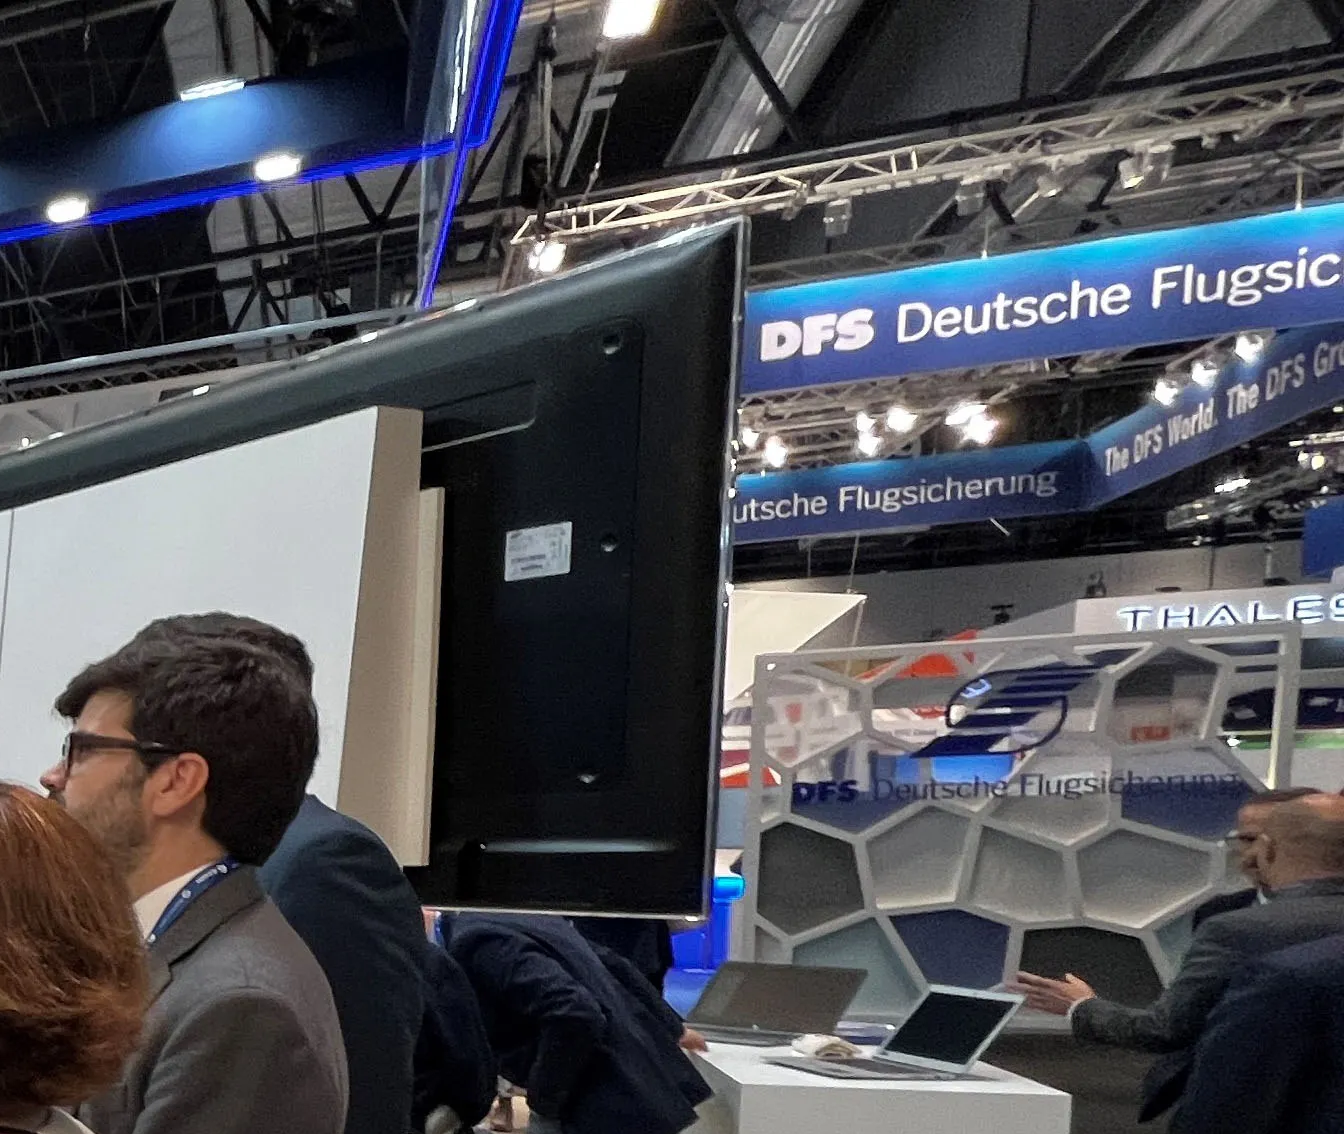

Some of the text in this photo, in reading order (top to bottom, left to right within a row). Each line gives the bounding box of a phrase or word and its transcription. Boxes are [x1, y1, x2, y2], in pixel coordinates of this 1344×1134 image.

[759, 246, 1342, 362] DFS Deutsche Flugsic
[1104, 447, 1130, 476] The
[1133, 423, 1163, 464] DFS
[1226, 383, 1260, 420] The
[1265, 353, 1306, 401] DFS
[839, 470, 1060, 513] Flugsicherung
[792, 770, 1242, 803] DFS Deutsche Flugsicherung
